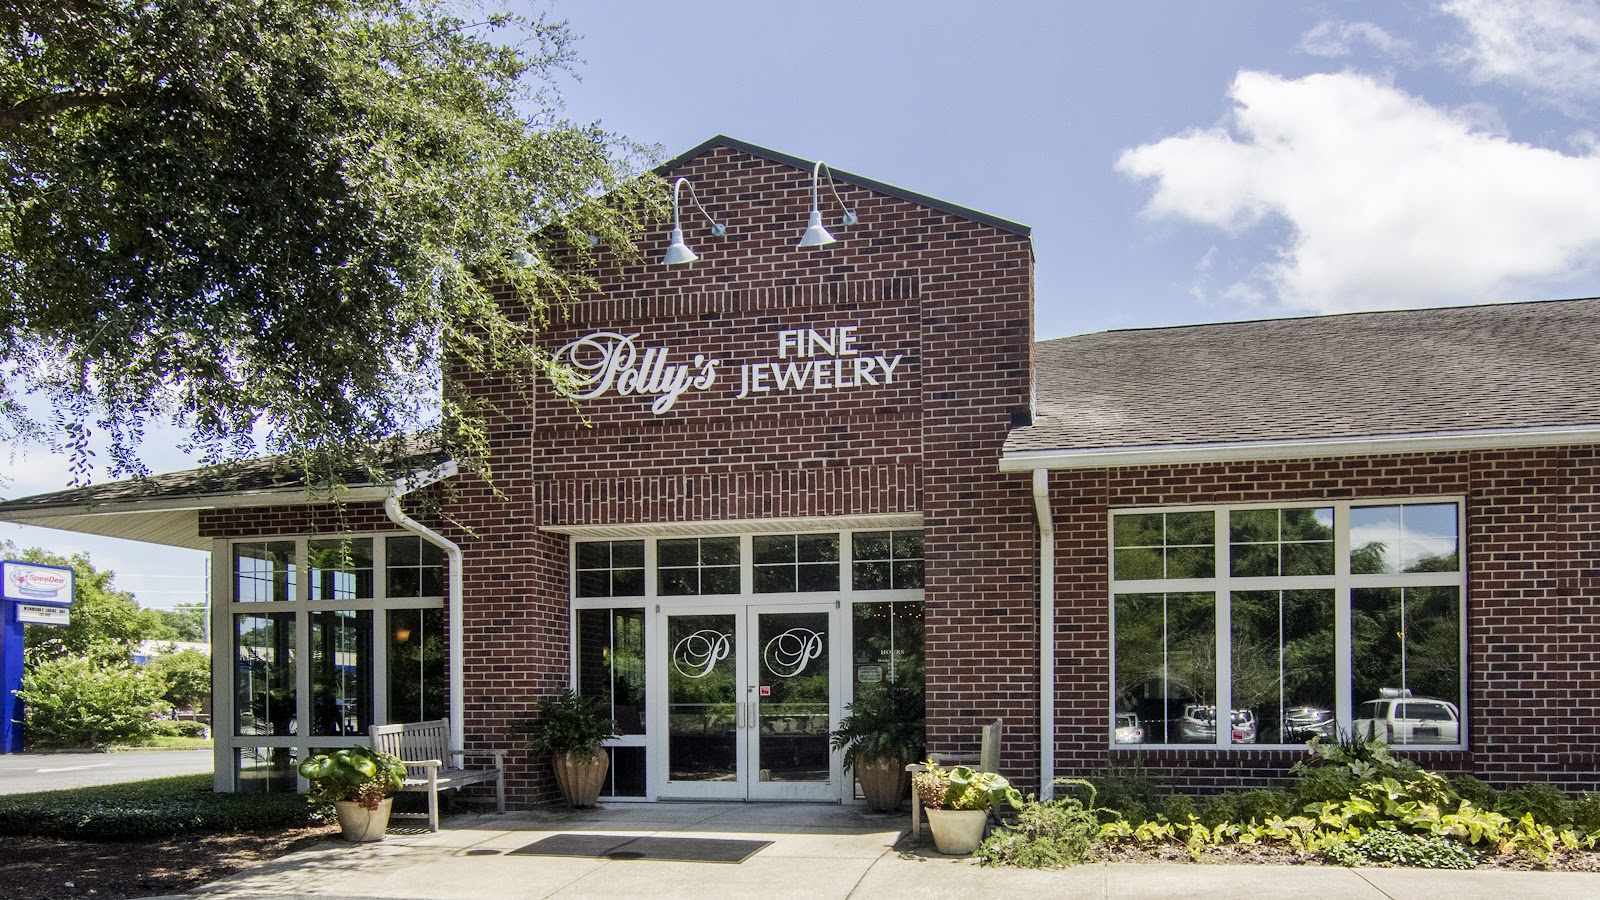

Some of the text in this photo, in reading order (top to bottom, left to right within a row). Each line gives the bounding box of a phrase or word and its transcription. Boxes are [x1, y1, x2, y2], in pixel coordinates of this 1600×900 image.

[779, 325, 858, 359] FINE
[549, 331, 720, 415] Polly's
[736, 354, 904, 399] JEWELRY
[29, 574, 65, 583] SpeeDee
[673, 629, 732, 678] P
[764, 627, 825, 678] P
